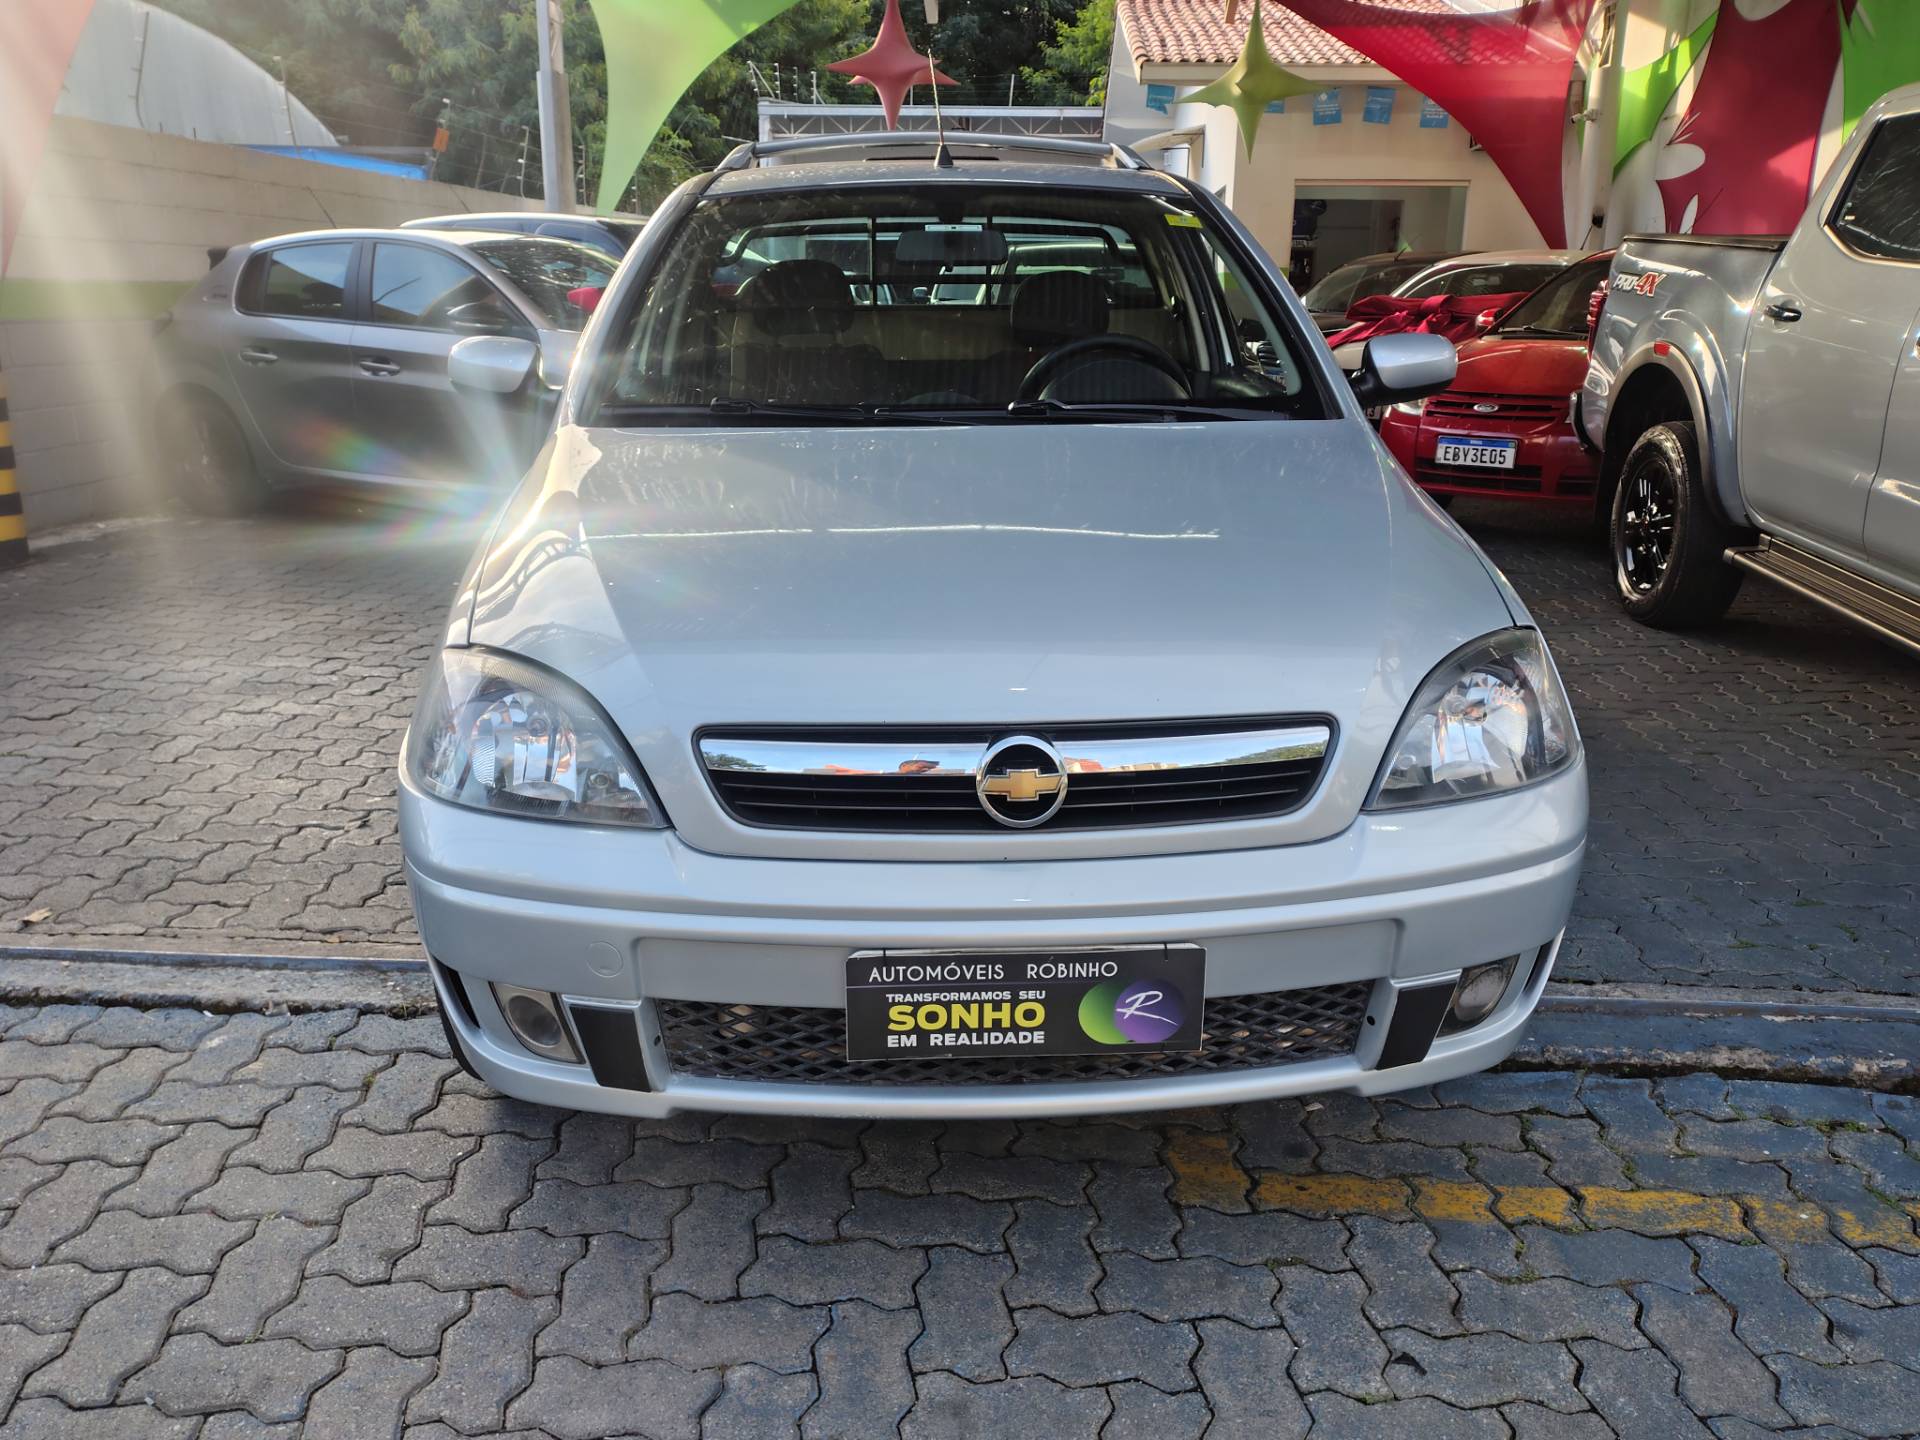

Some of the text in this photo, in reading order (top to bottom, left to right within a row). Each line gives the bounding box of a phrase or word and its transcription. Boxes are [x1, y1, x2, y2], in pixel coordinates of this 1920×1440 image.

[1443, 446, 1506, 465] EBY3E05
[869, 962, 1004, 983] AUTOMÓVEIS
[886, 990, 1046, 1002] TRANSFORMAMOS SEU
[888, 1001, 1045, 1031] SONHO
[887, 1031, 1045, 1048] EM REALIDADE
